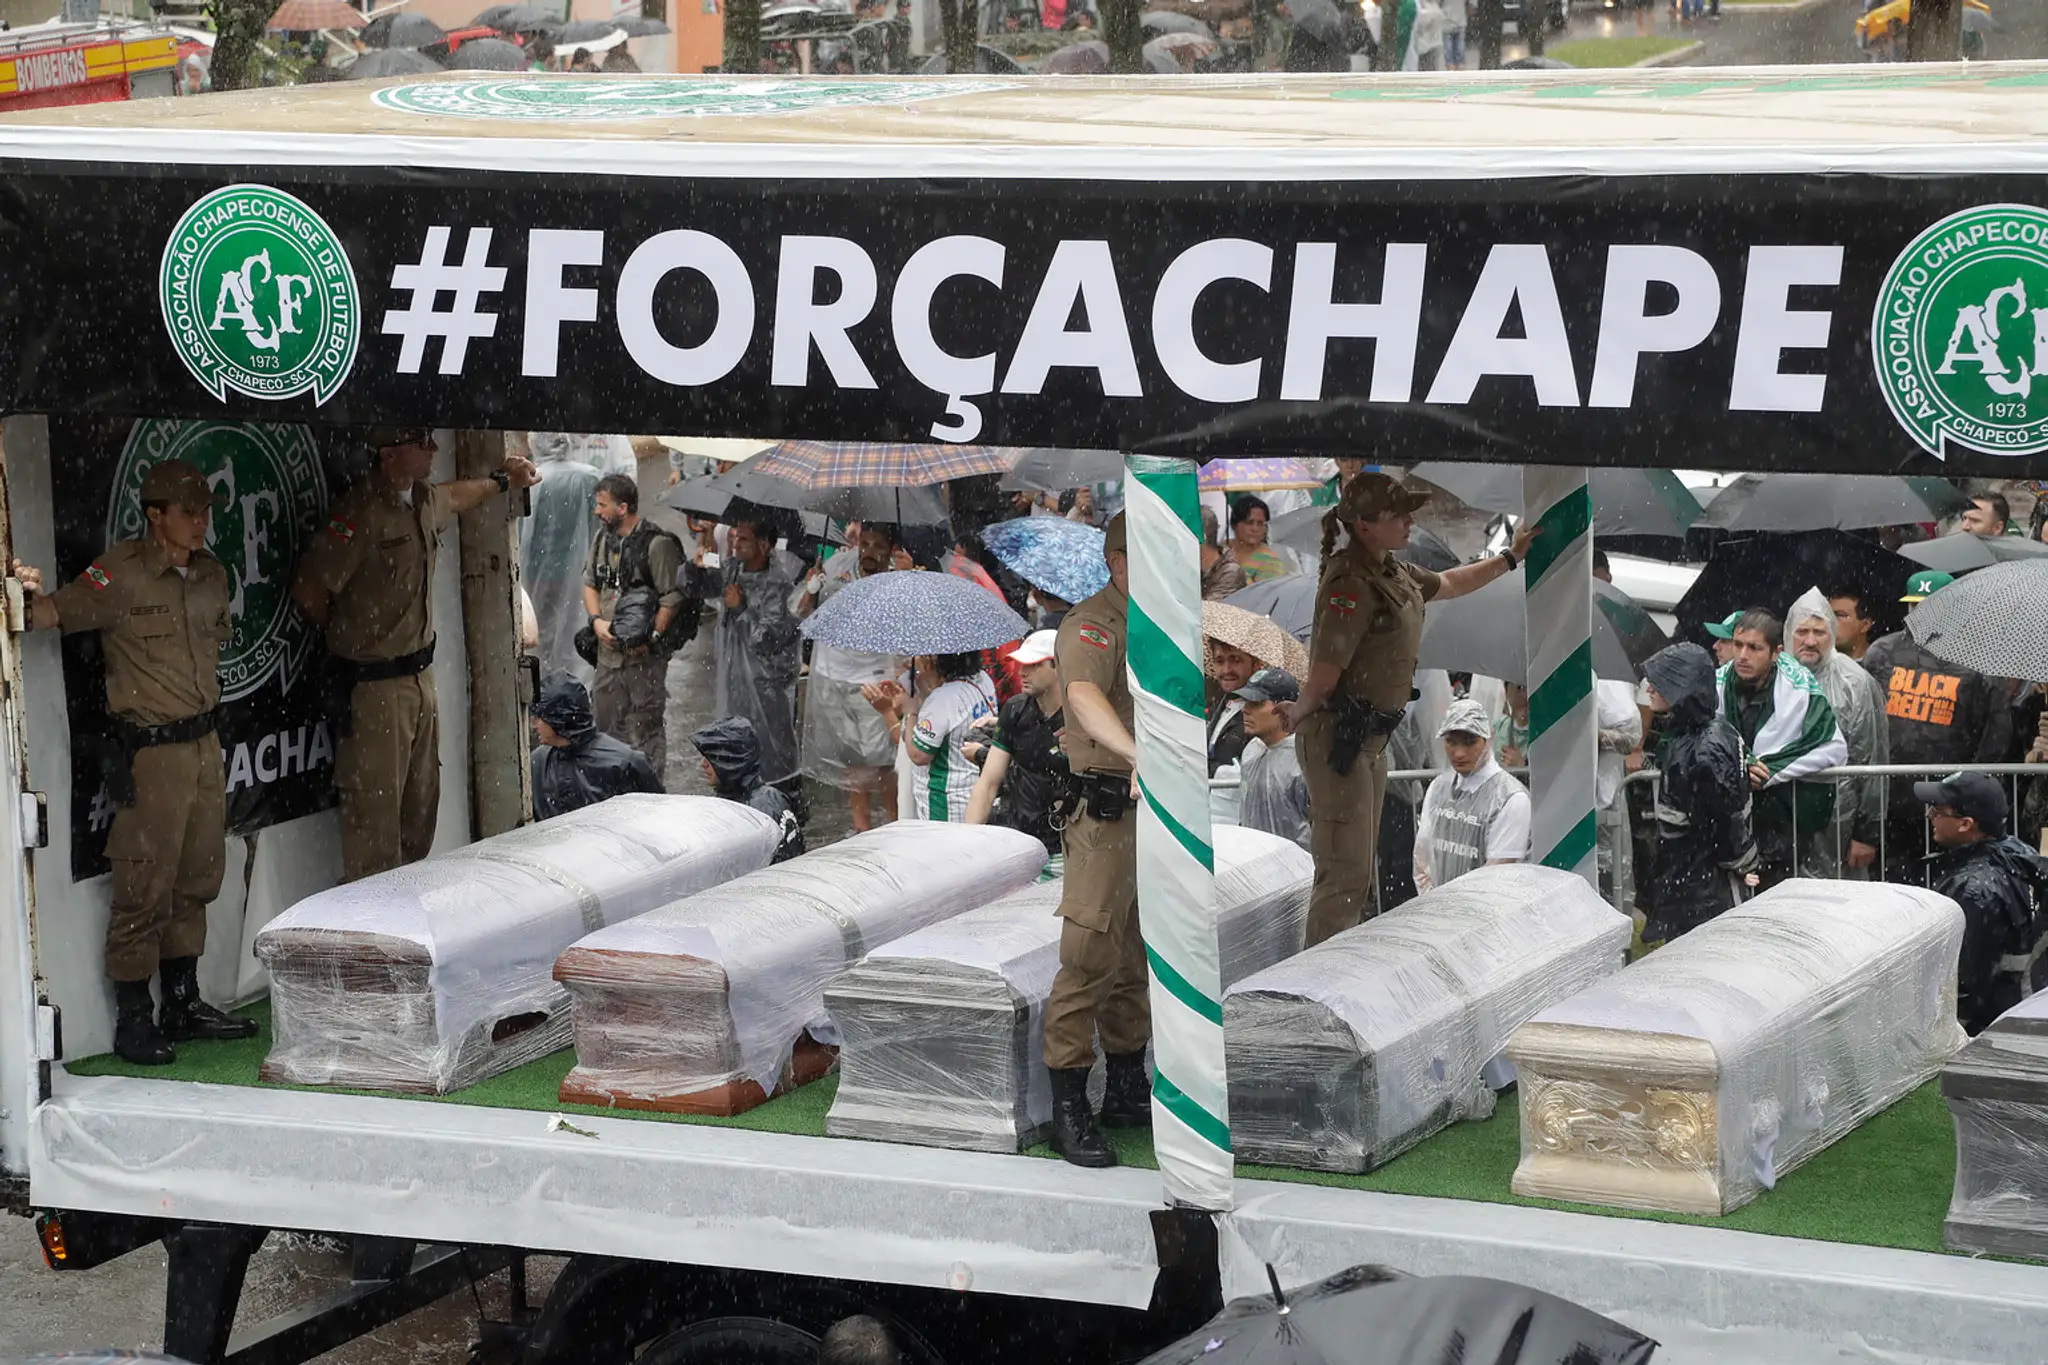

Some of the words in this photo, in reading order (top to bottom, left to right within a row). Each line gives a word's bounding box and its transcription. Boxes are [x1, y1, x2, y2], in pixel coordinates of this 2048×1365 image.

[15, 49, 86, 92] BOMBEIROS
[193, 198, 323, 250] CHAPECOENSE
[317, 248, 341, 280] DE
[172, 236, 215, 369] ASSOCIAÇÃO
[317, 282, 348, 374] FUTEBOL
[381, 226, 1845, 443] #FORÇACHAPE
[1889, 266, 1937, 420] ASSOCIAÇÃO
[250, 355, 280, 369] 1973
[1985, 402, 2028, 419] 1973
[1889, 666, 1961, 702] BLACK
[1886, 691, 1935, 722] BELT
